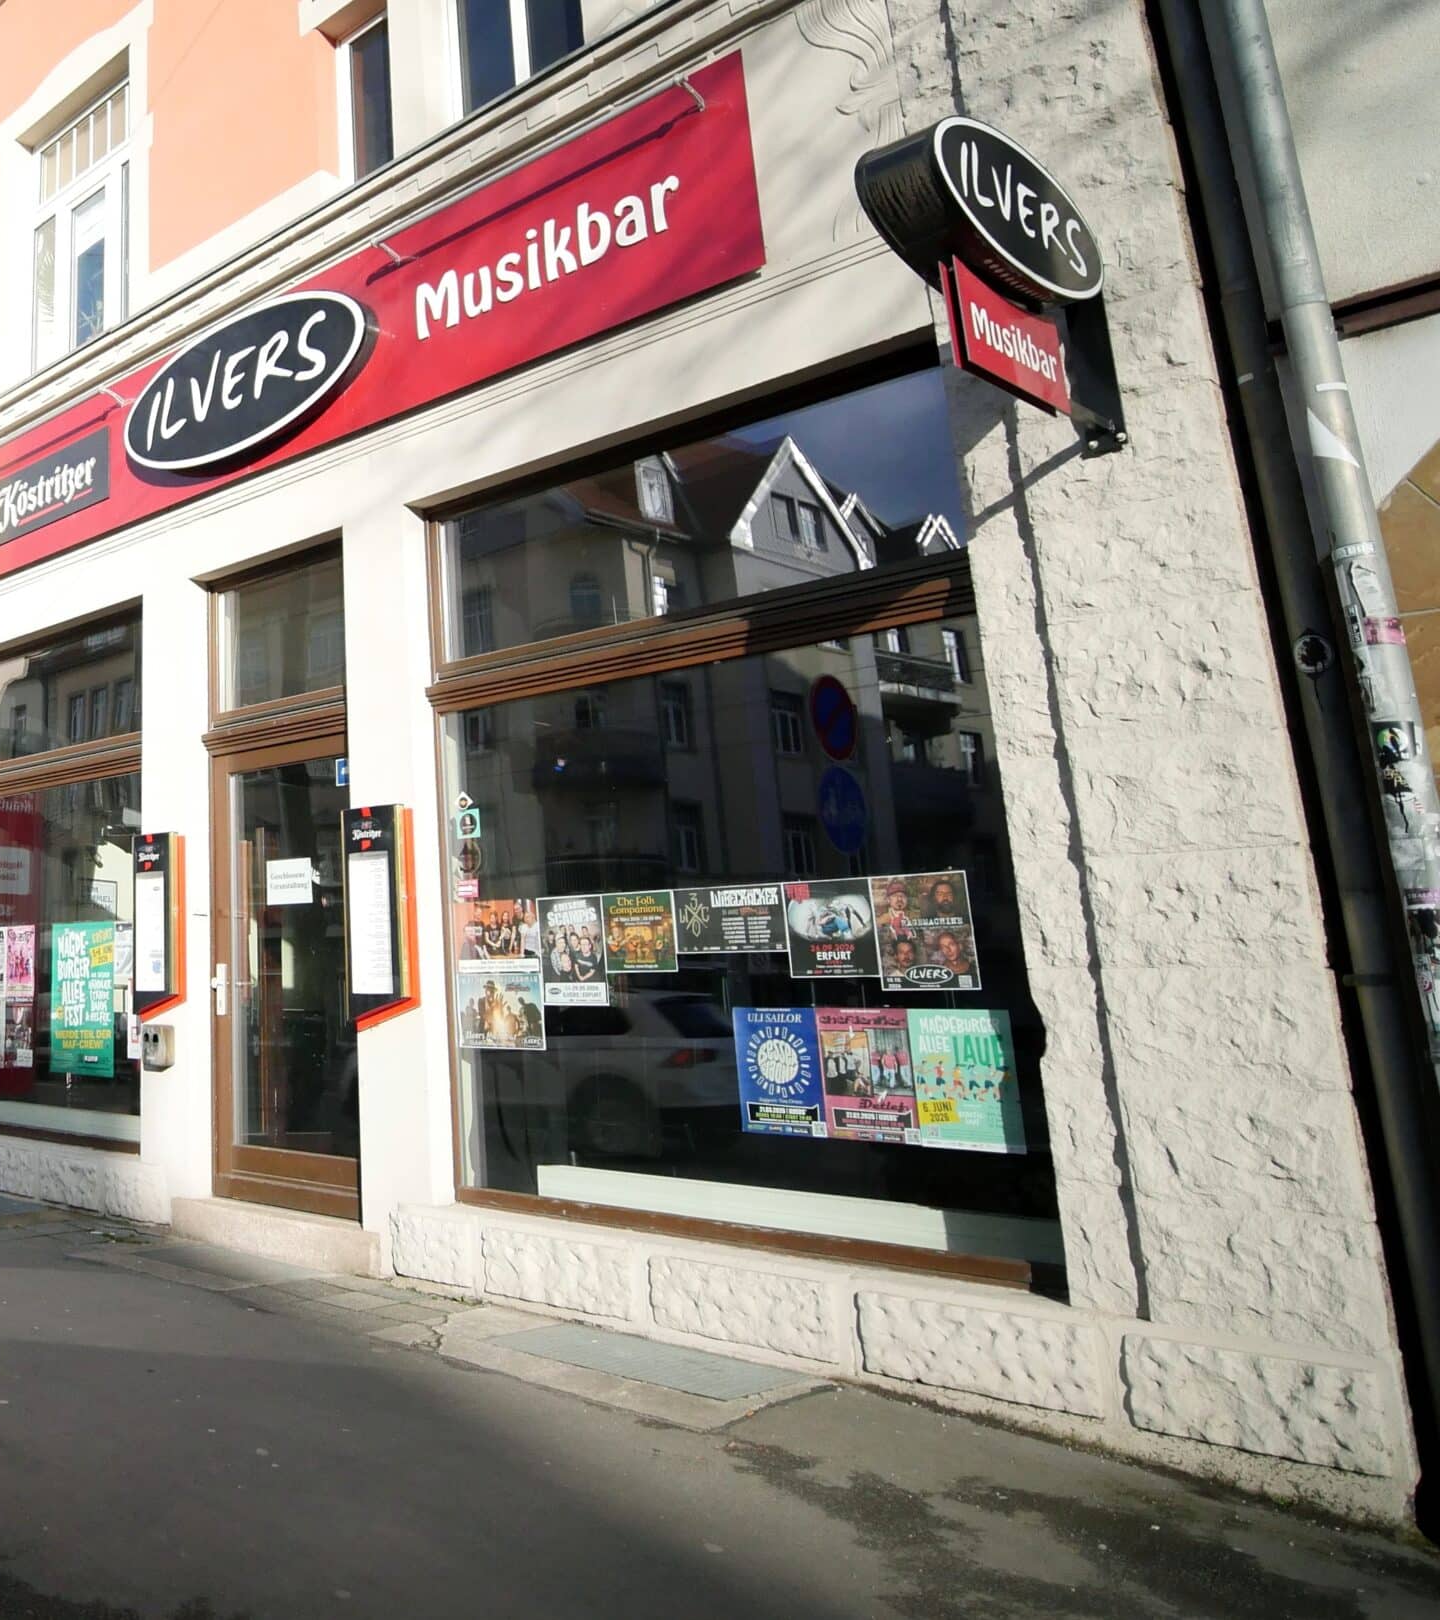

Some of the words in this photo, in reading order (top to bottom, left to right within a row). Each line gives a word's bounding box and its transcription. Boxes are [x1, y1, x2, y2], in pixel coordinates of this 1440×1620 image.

[960, 140, 1088, 278] ILVERS
[415, 175, 680, 340] Musikbar
[970, 301, 1058, 382] Musikbar
[146, 309, 327, 452] ILVERS
[609, 905, 664, 915] Companions
[616, 896, 634, 906] The
[816, 951, 852, 961] ERFURT
[57, 957, 90, 981] BURGER
[909, 968, 949, 980] ILVERS
[62, 980, 85, 1006] ALLEE
[64, 1003, 84, 1028] FEST
[747, 1013, 764, 1022] ULI
[765, 1013, 802, 1023] SAILOR
[920, 1016, 1000, 1033] MAGDEBURGER
[920, 1035, 952, 1053] ALLEE
[952, 1034, 1005, 1070] LAUF
[931, 1101, 952, 1112] JUNI
[929, 1113, 950, 1121] 2026
